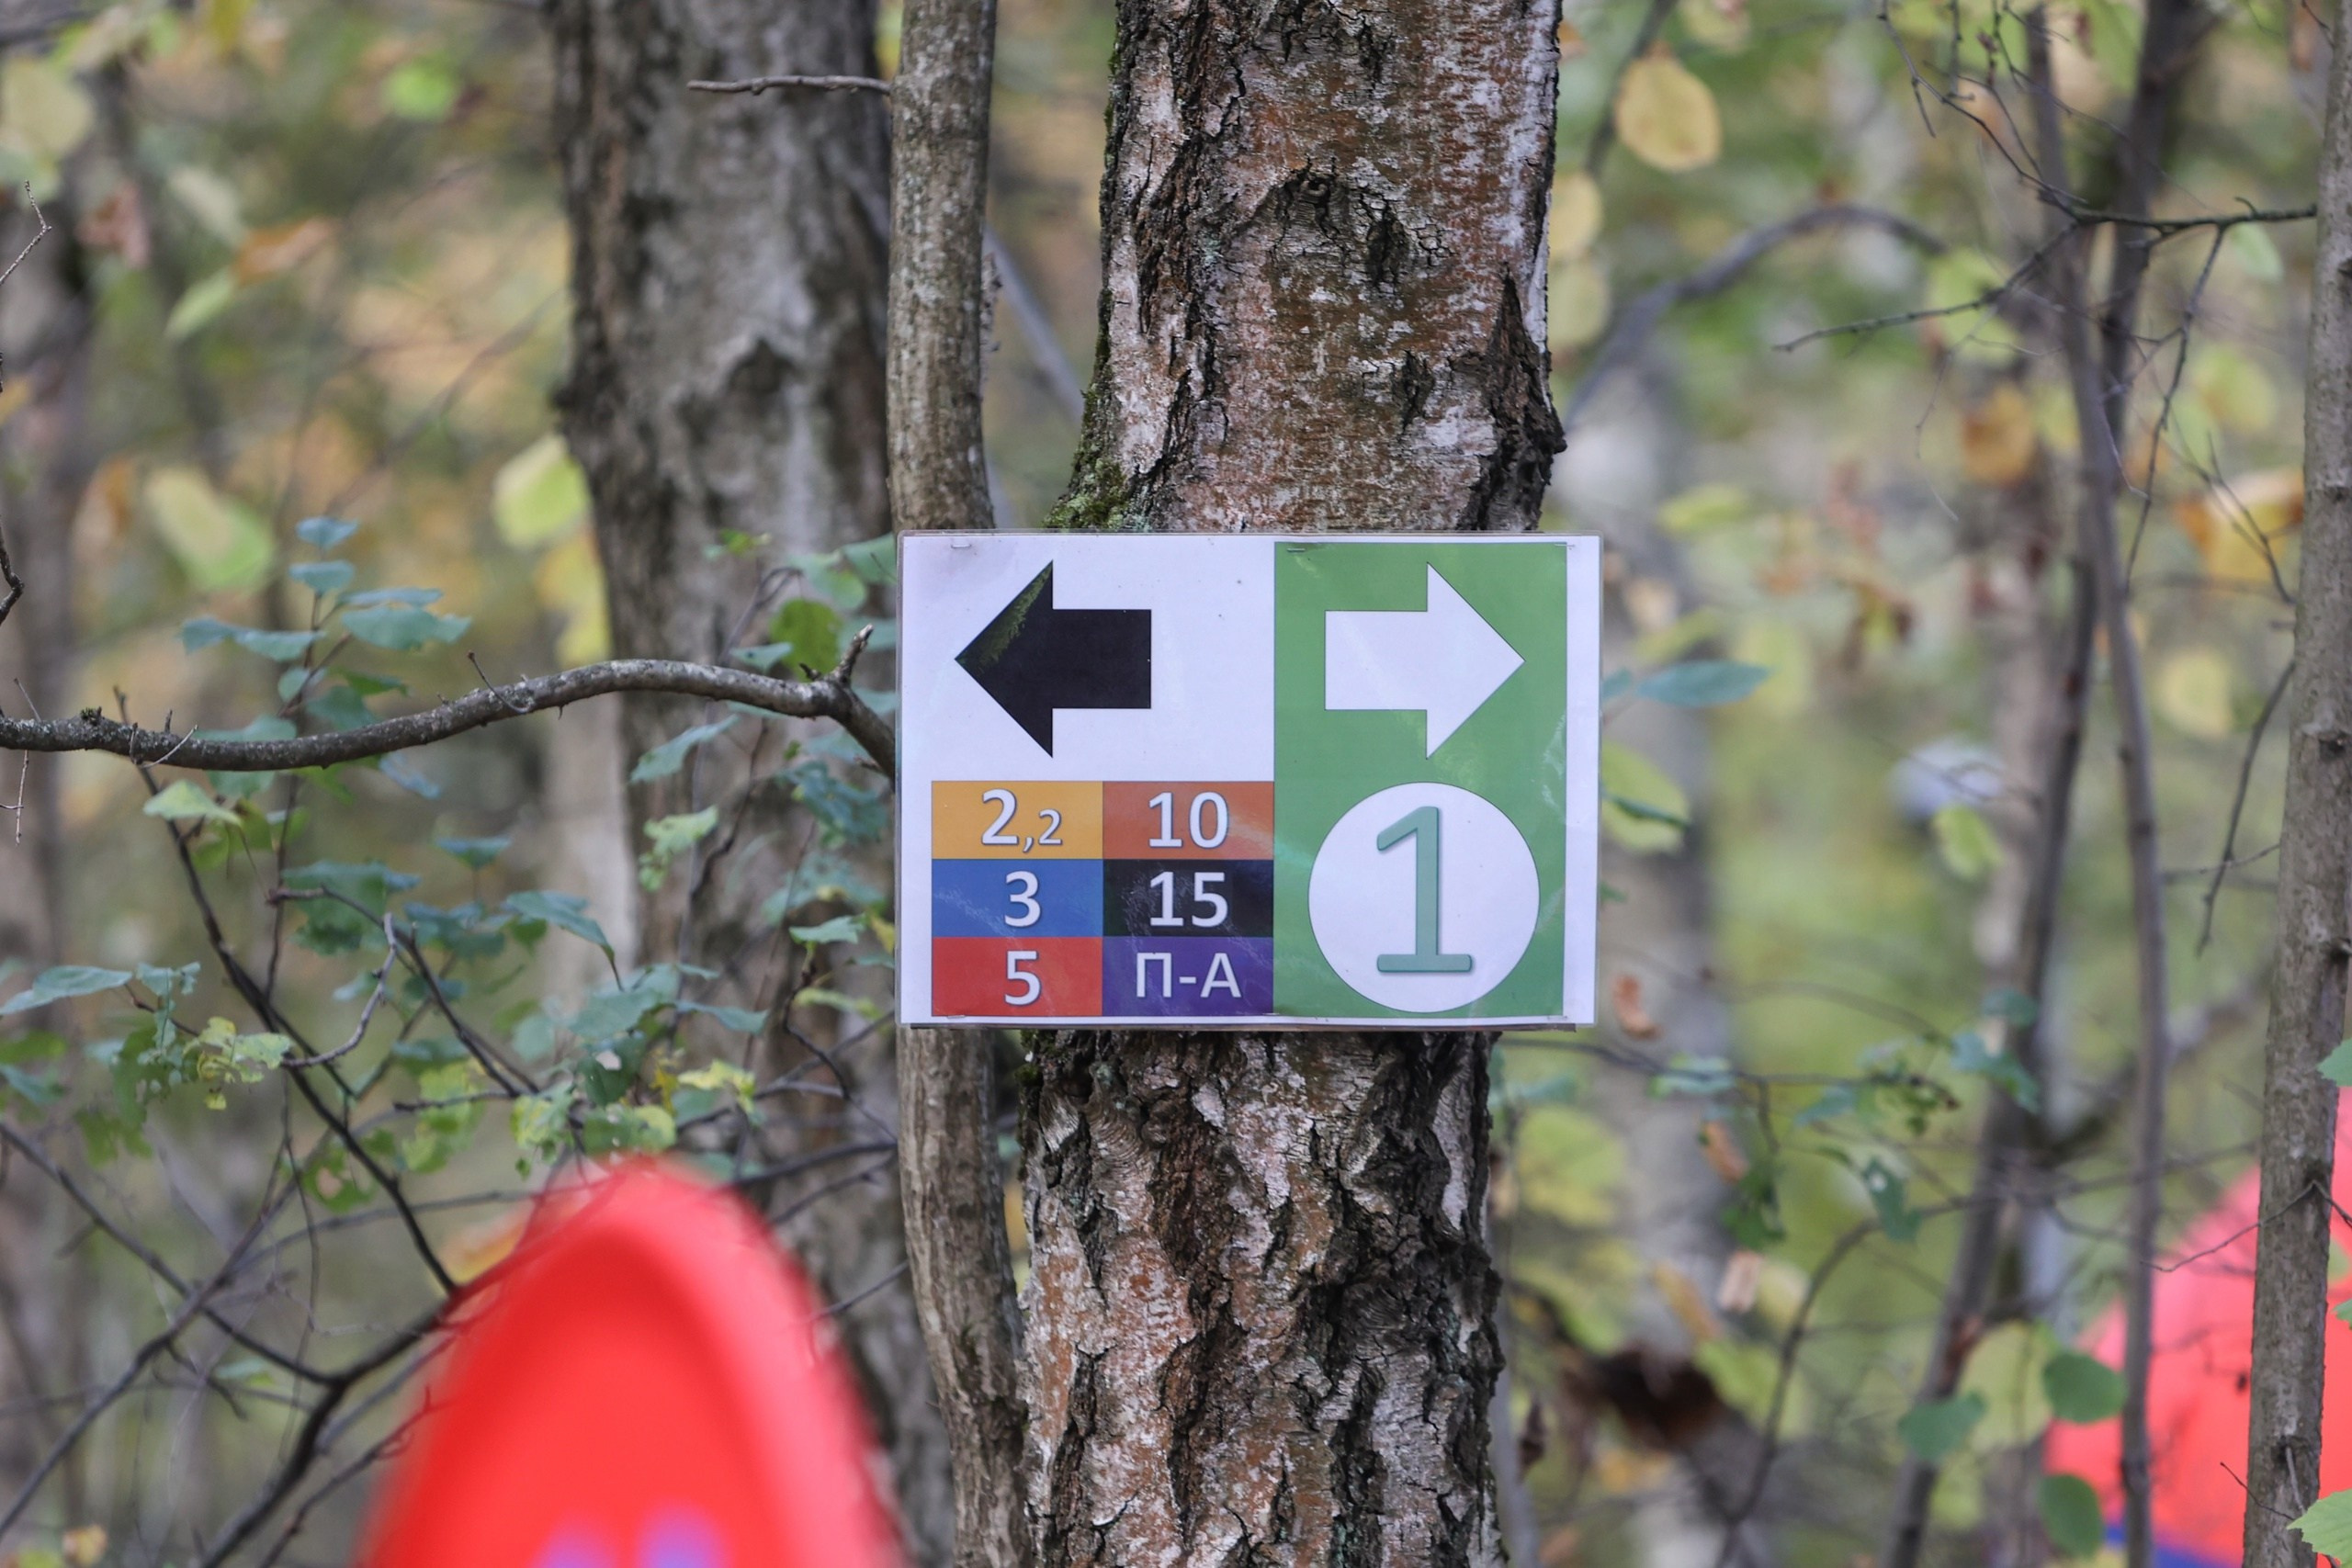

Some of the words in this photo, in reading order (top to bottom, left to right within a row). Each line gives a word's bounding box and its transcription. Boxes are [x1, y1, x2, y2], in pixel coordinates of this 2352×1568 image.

[981, 788, 1062, 853] 2,2
[1148, 792, 1228, 848] 10
[1004, 871, 1041, 927] 3
[1149, 871, 1228, 927] 15
[1377, 806, 1472, 973] 1
[1004, 951, 1041, 1005] 5
[1136, 952, 1241, 998] П-А
